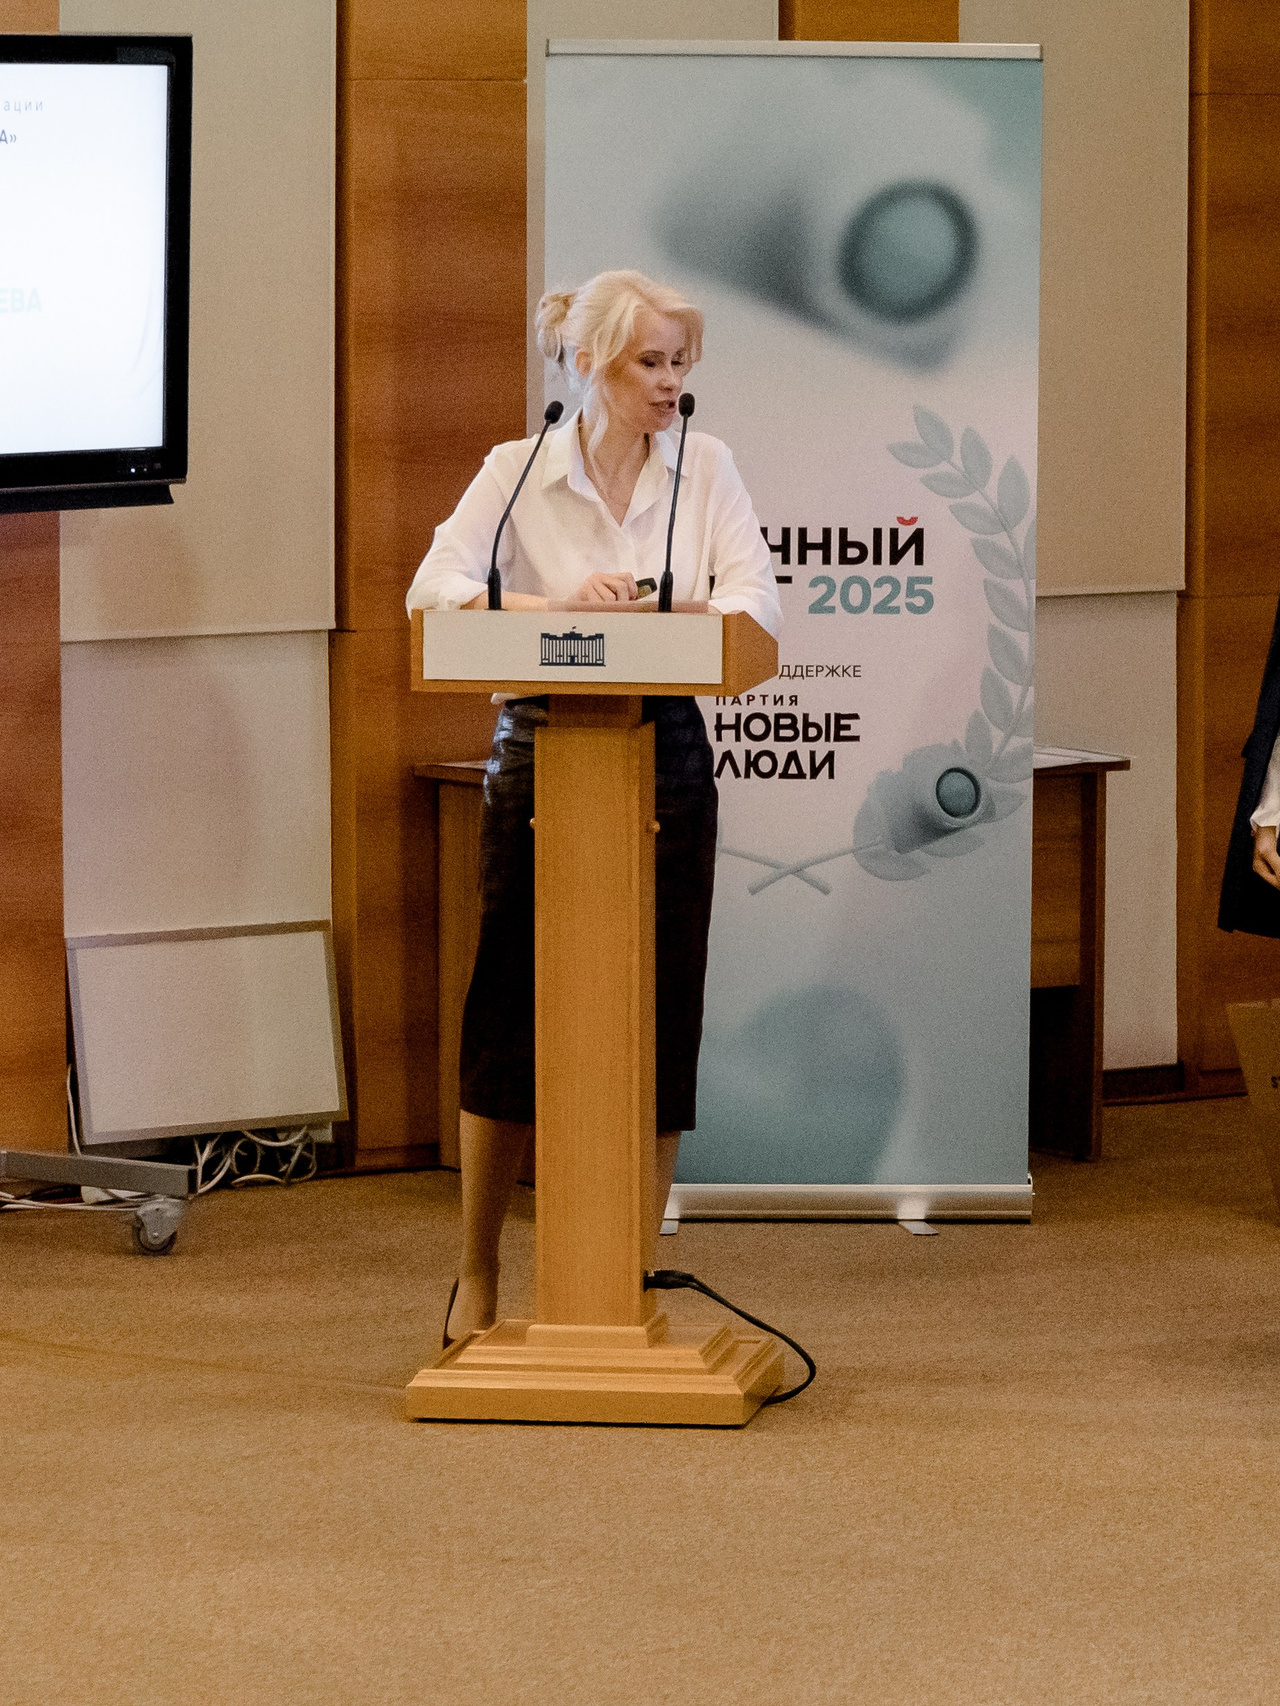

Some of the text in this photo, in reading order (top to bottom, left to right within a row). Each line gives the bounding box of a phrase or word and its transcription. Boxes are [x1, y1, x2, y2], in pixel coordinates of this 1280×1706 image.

[807, 575, 935, 615] 2025
[778, 664, 862, 680] ДДЕРЖКЕ
[715, 694, 799, 707] ПАРТИЯ
[714, 712, 861, 743] НОВЫЕ
[713, 748, 836, 781] ЛЮДИ
